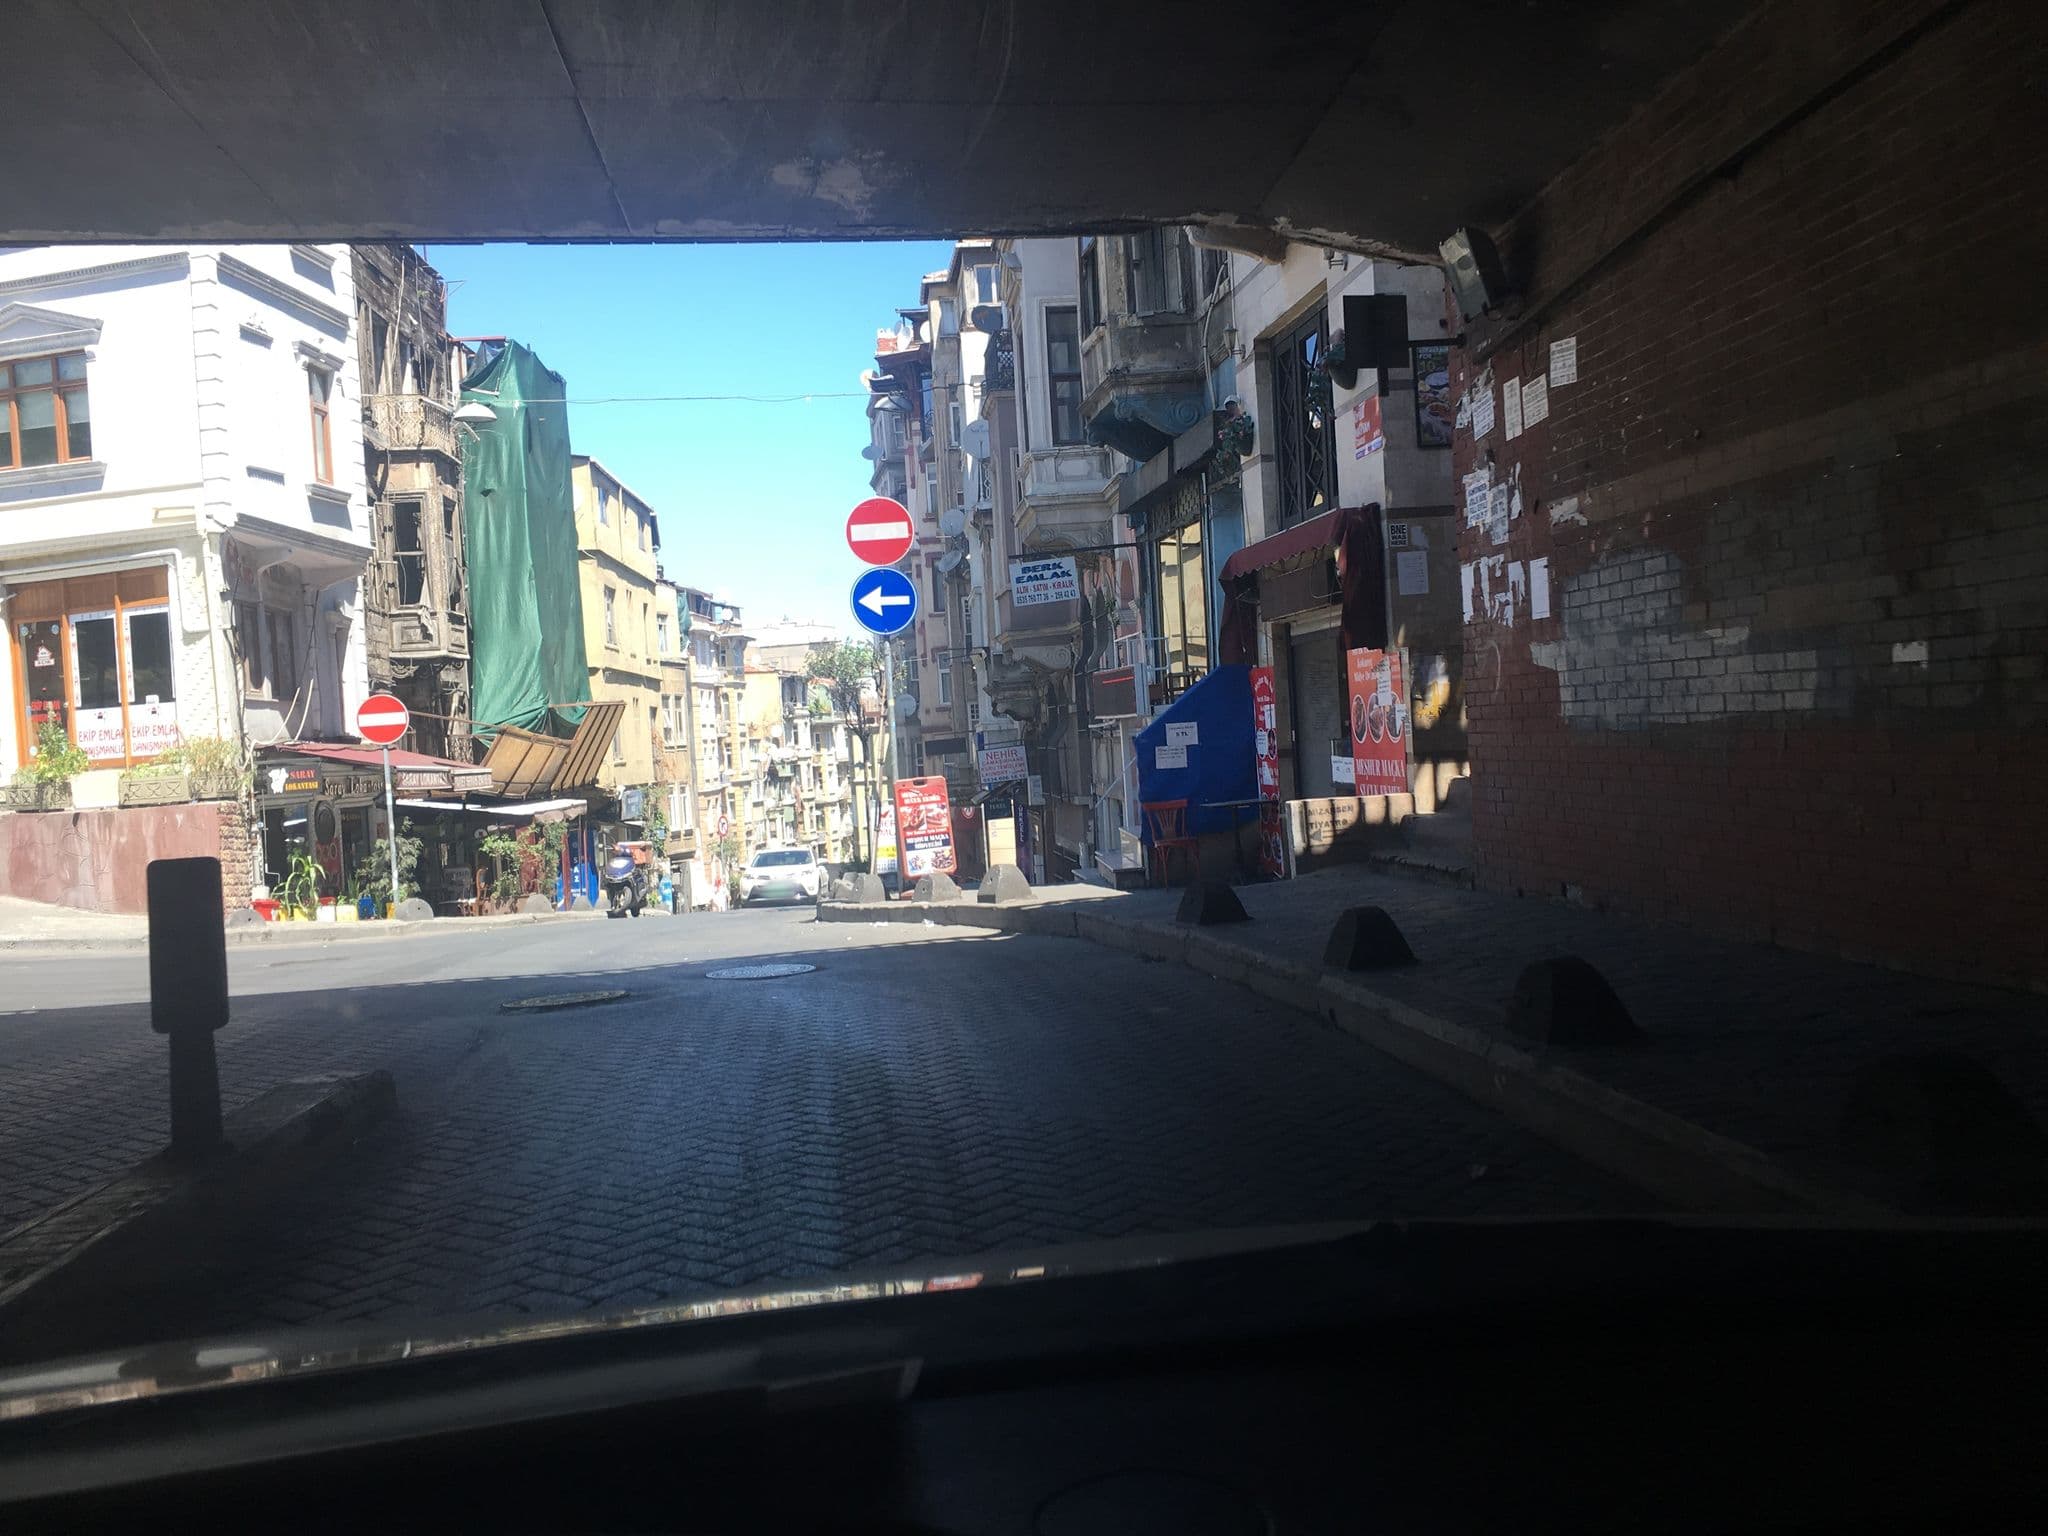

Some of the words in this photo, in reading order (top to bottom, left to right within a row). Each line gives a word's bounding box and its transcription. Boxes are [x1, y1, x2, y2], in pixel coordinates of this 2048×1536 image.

[1391, 524, 1406, 535] BNE
[1021, 562, 1063, 574] BERK
[1015, 570, 1072, 584] EMLAK
[79, 730, 96, 743] EKİP
[132, 725, 149, 737] EKİP
[289, 770, 315, 779] SARAY
[1381, 759, 1405, 782] MAÇKA
[285, 781, 319, 791] LOKANTASI
[324, 777, 347, 797] Saray
